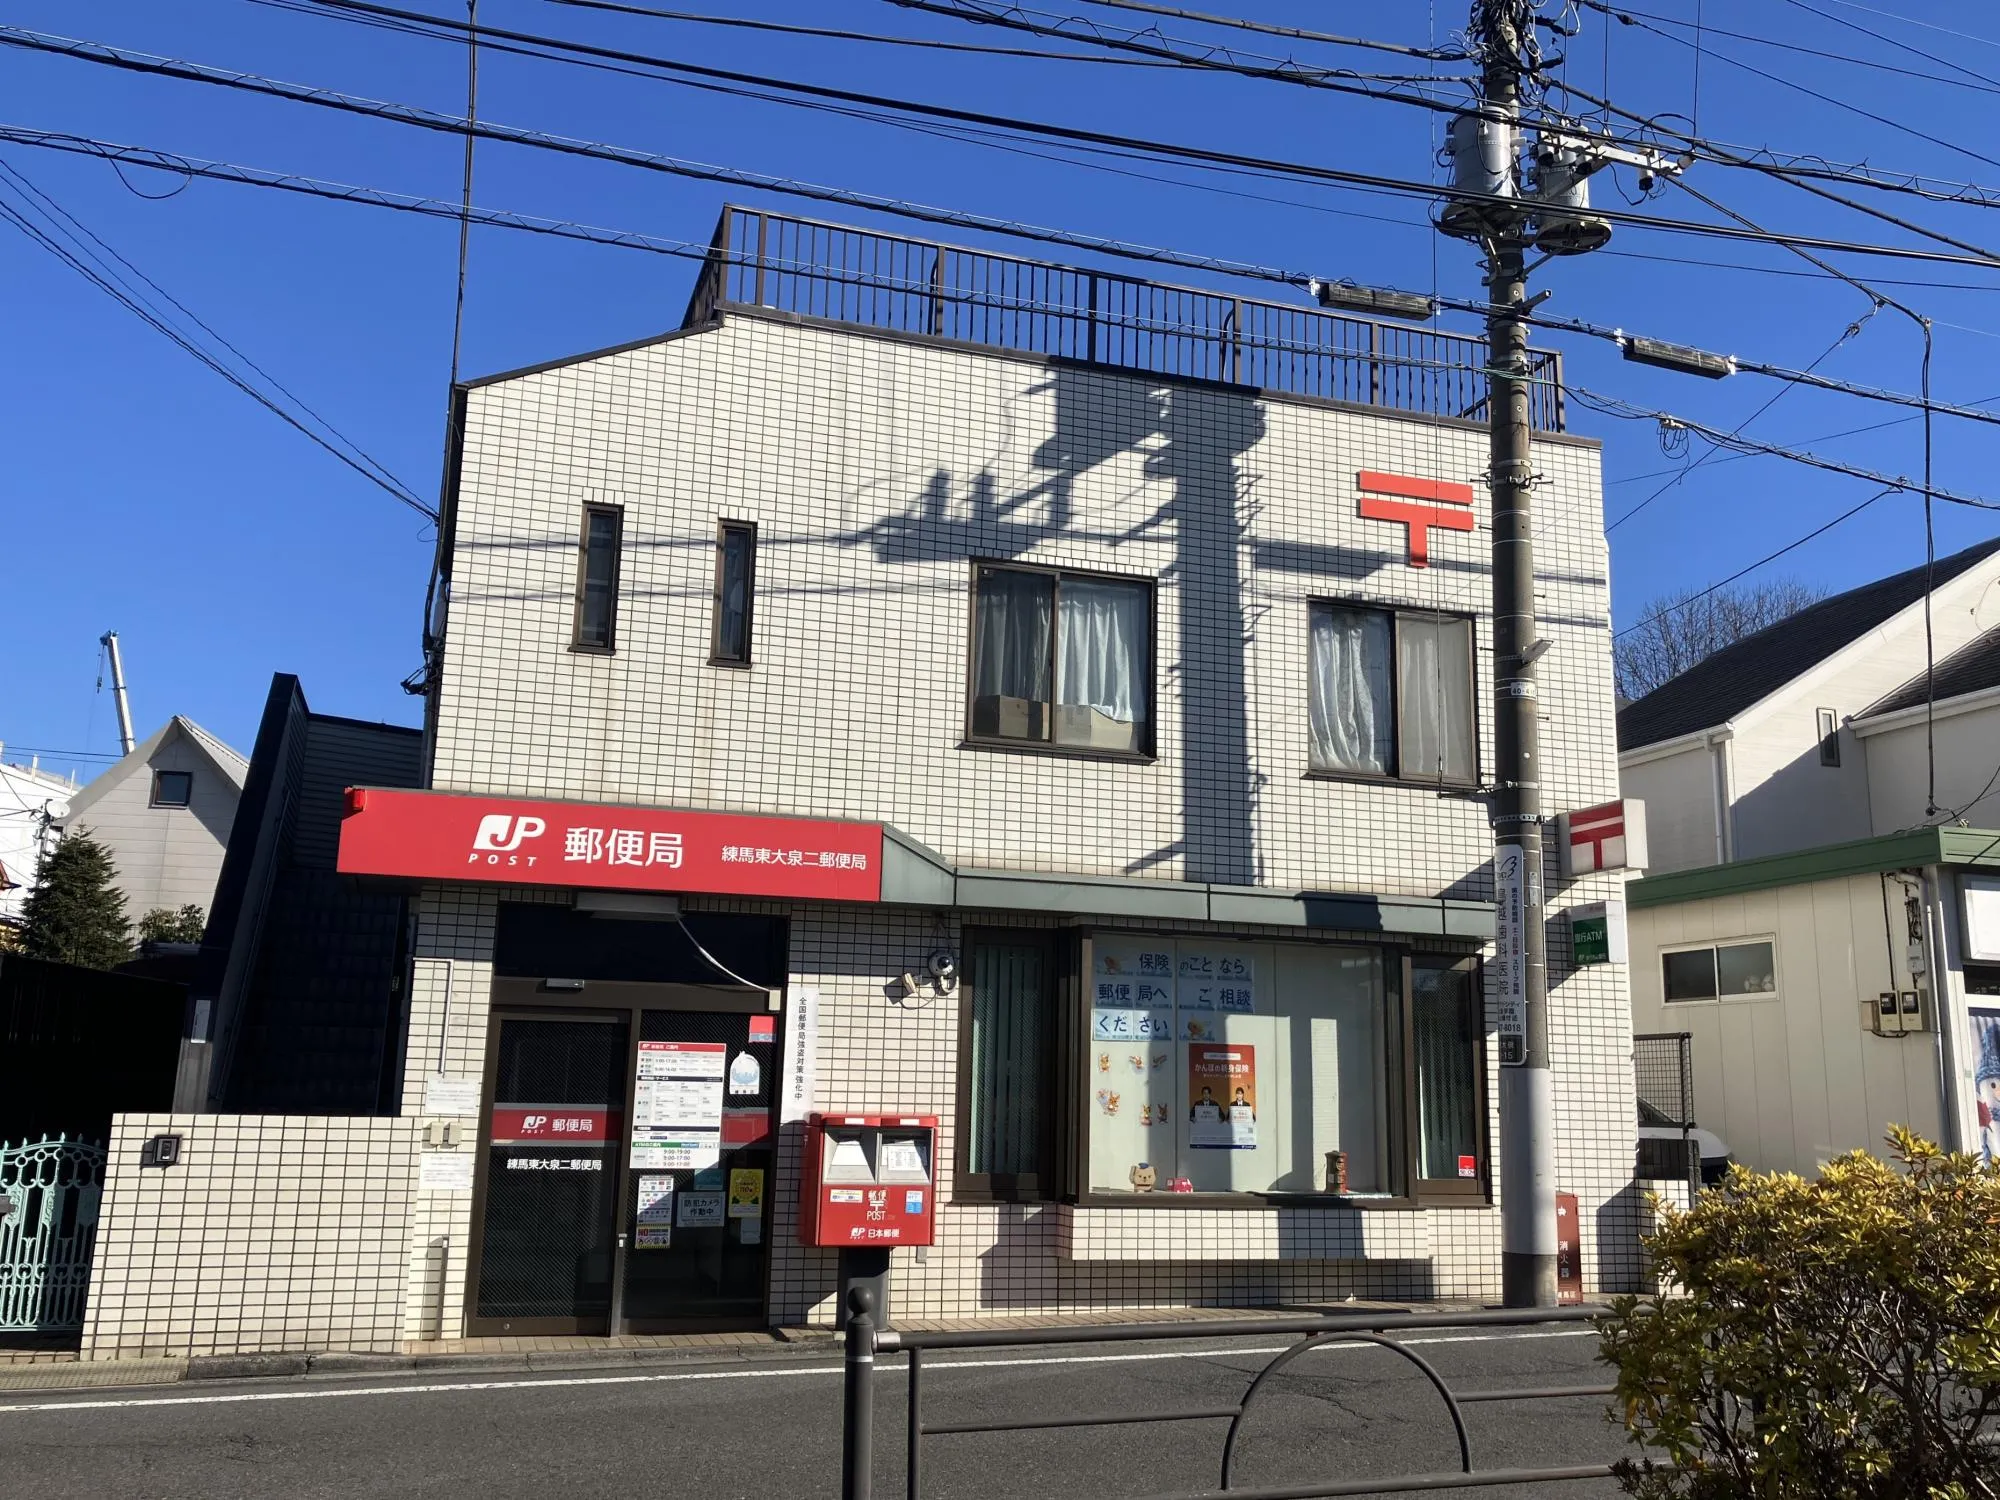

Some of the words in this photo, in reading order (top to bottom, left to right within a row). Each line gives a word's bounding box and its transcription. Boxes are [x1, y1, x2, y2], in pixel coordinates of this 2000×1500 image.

[473, 814, 546, 851] JP
[564, 826, 683, 869] 郵便局
[468, 853, 537, 867] POST
[721, 845, 867, 870] 練馬東大泉二郵便局
[1098, 983, 1168, 1001] 郵便局へ
[1199, 987, 1251, 1006] ご相談
[1099, 1015, 1168, 1032] ください
[522, 1115, 547, 1129] JP
[551, 1118, 593, 1132] 郵便局
[506, 1158, 602, 1171] 練馬東大泉二郵便局
[867, 1189, 887, 1201] 郵便
[684, 1199, 720, 1207] 防犯カメラ
[690, 1208, 714, 1216] 作動中
[866, 1211, 886, 1221] POST
[868, 1229, 900, 1238] 日本郵便
[1560, 1240, 1569, 1278] 消火器
